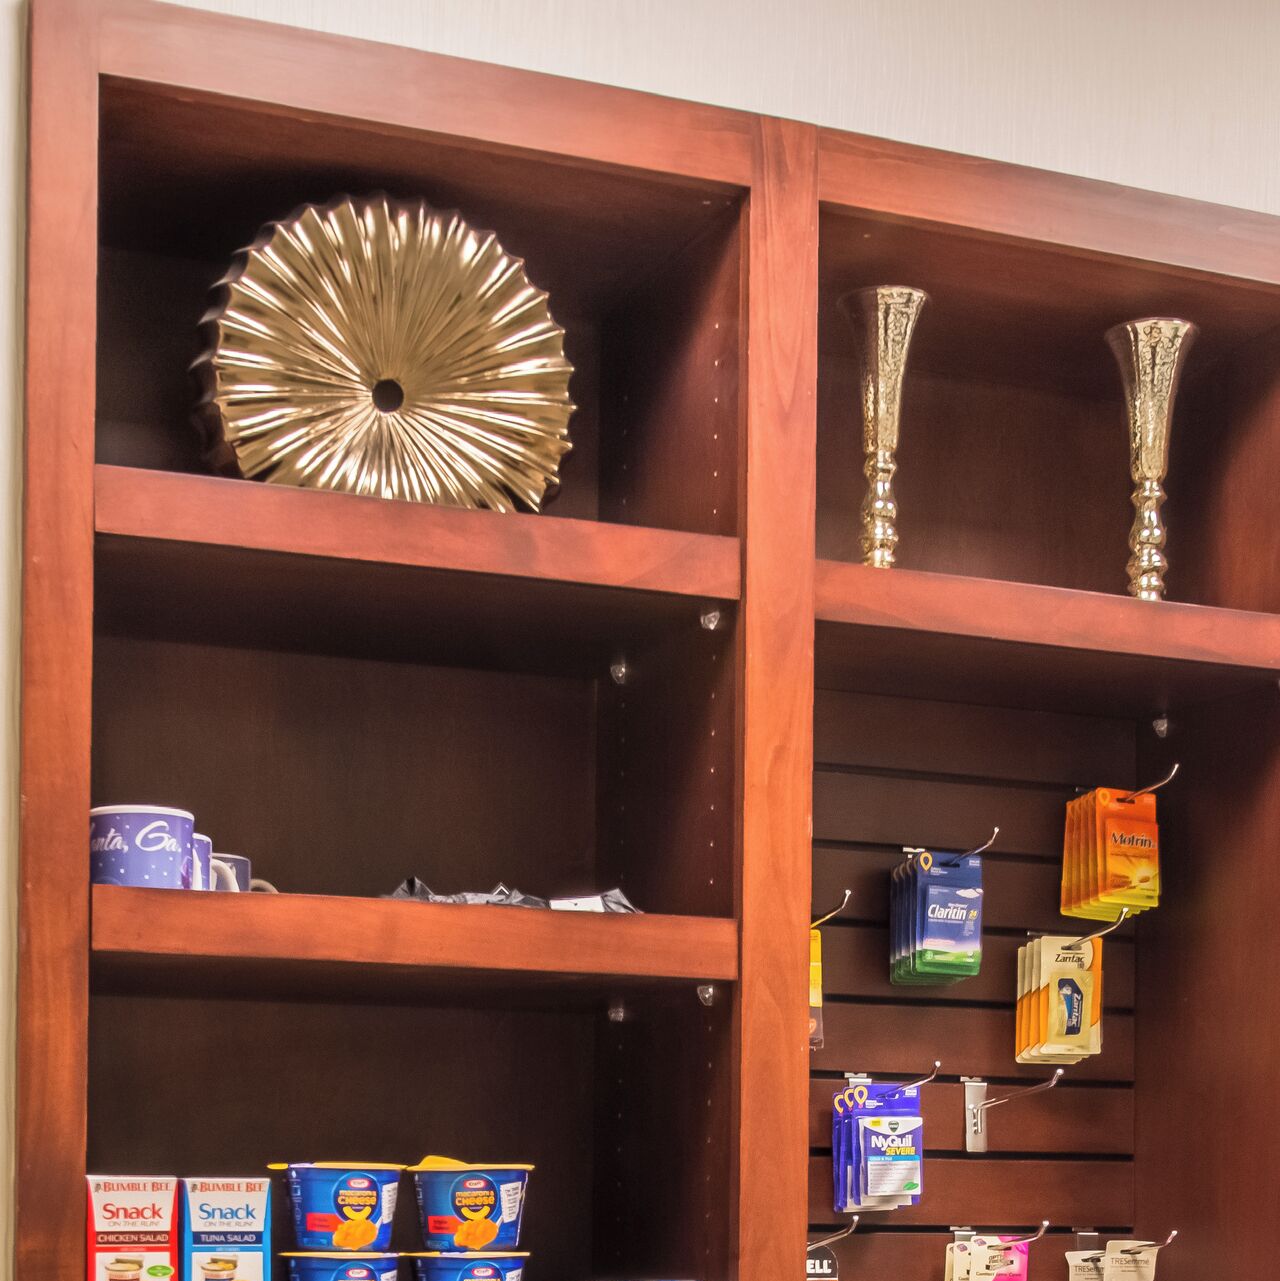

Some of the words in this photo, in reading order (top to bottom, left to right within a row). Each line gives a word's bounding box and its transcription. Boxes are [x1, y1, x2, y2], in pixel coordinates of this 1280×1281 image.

[135, 820, 182, 852] Ga.
[1110, 832, 1153, 848] Motrin
[928, 904, 967, 920] Claritin
[1055, 954, 1086, 963] Zantac
[871, 1135, 913, 1151] NyQuil
[886, 1147, 916, 1156] SEVERE
[103, 1182, 148, 1192] BUMBLE
[152, 1182, 171, 1192] BEE
[200, 1182, 241, 1192] BUMBLE
[245, 1182, 265, 1192] BEE
[102, 1203, 163, 1220] Snack
[199, 1203, 256, 1220] Snack
[98, 1234, 139, 1243] CHICKEN
[140, 1234, 169, 1243] SALAD
[200, 1234, 226, 1243] TUNA
[227, 1234, 256, 1243] SALAD
[806, 1260, 831, 1274] ELL
